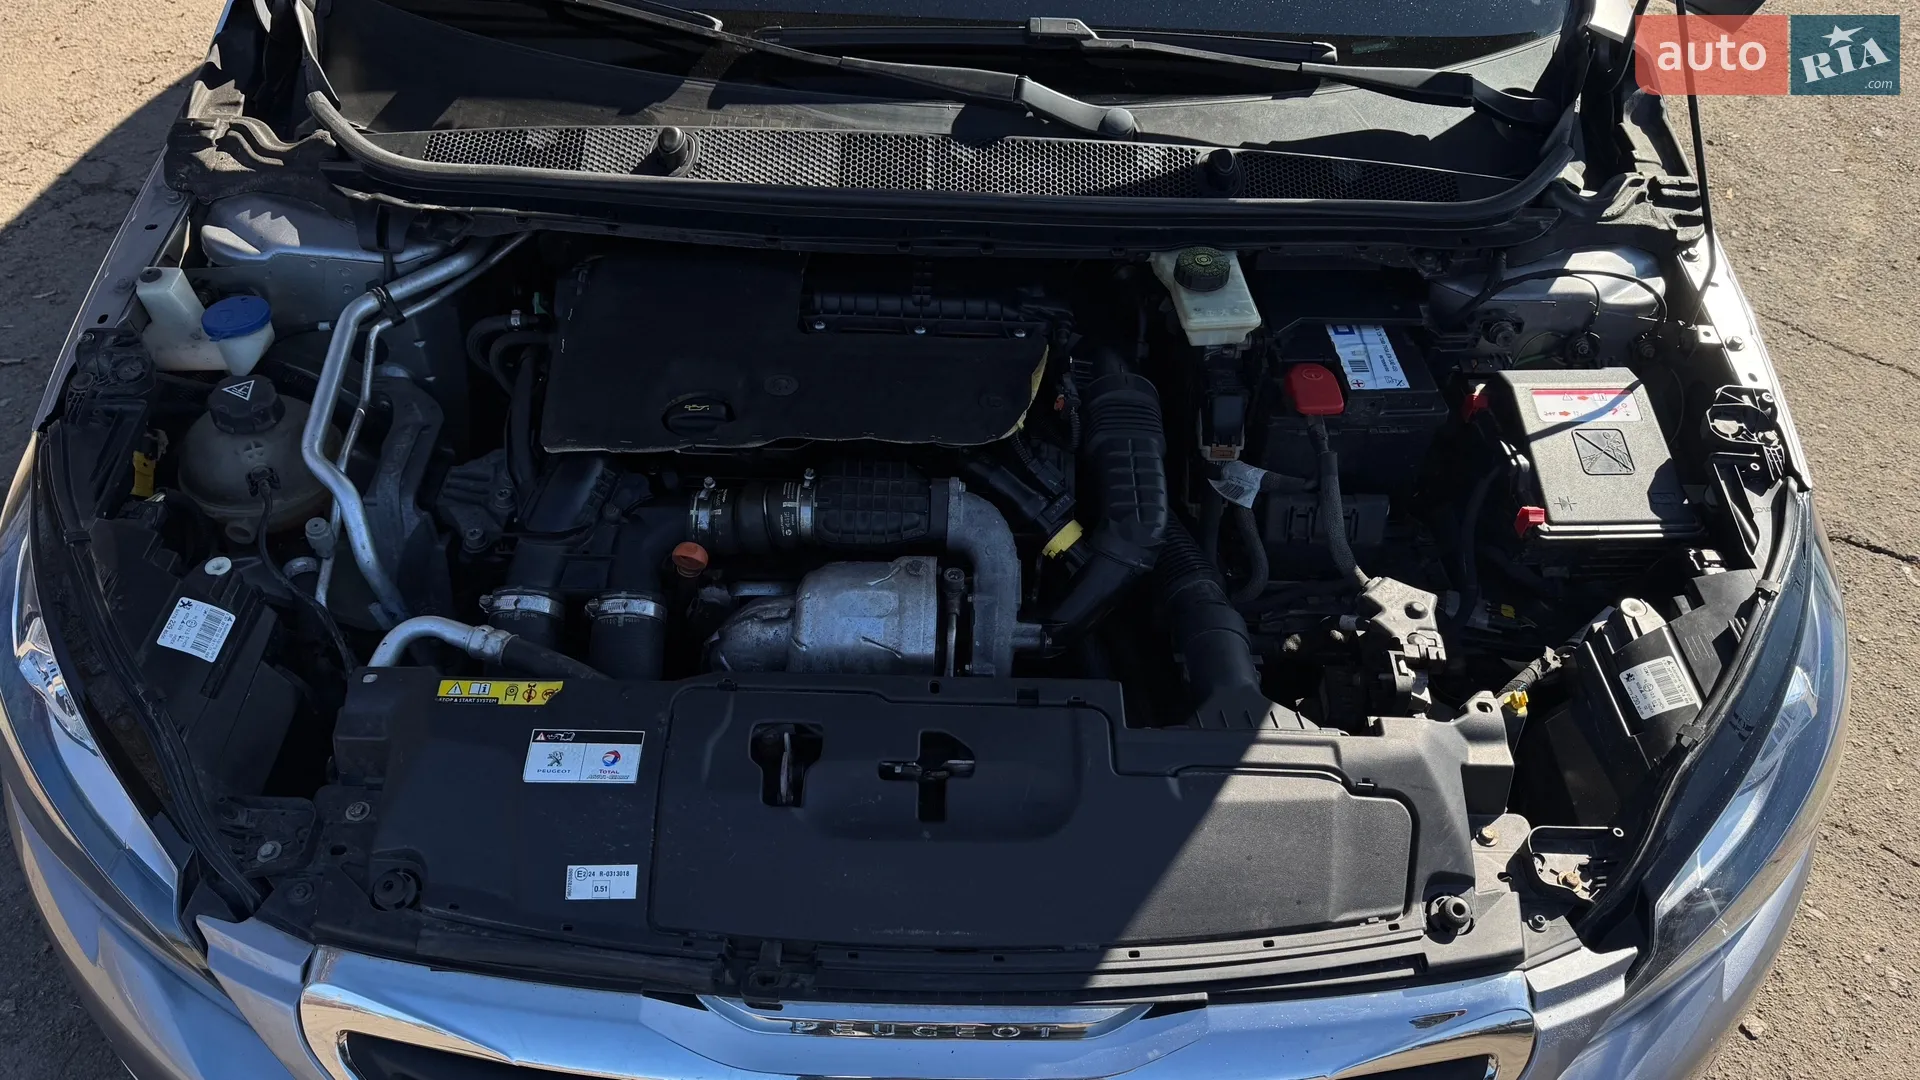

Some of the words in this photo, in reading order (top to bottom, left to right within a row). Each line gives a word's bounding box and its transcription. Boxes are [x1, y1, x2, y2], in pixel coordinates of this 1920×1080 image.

[166, 619, 175, 630] 229
[1631, 694, 1640, 705] 230
[791, 1021, 1059, 1038] PEUGEOT
